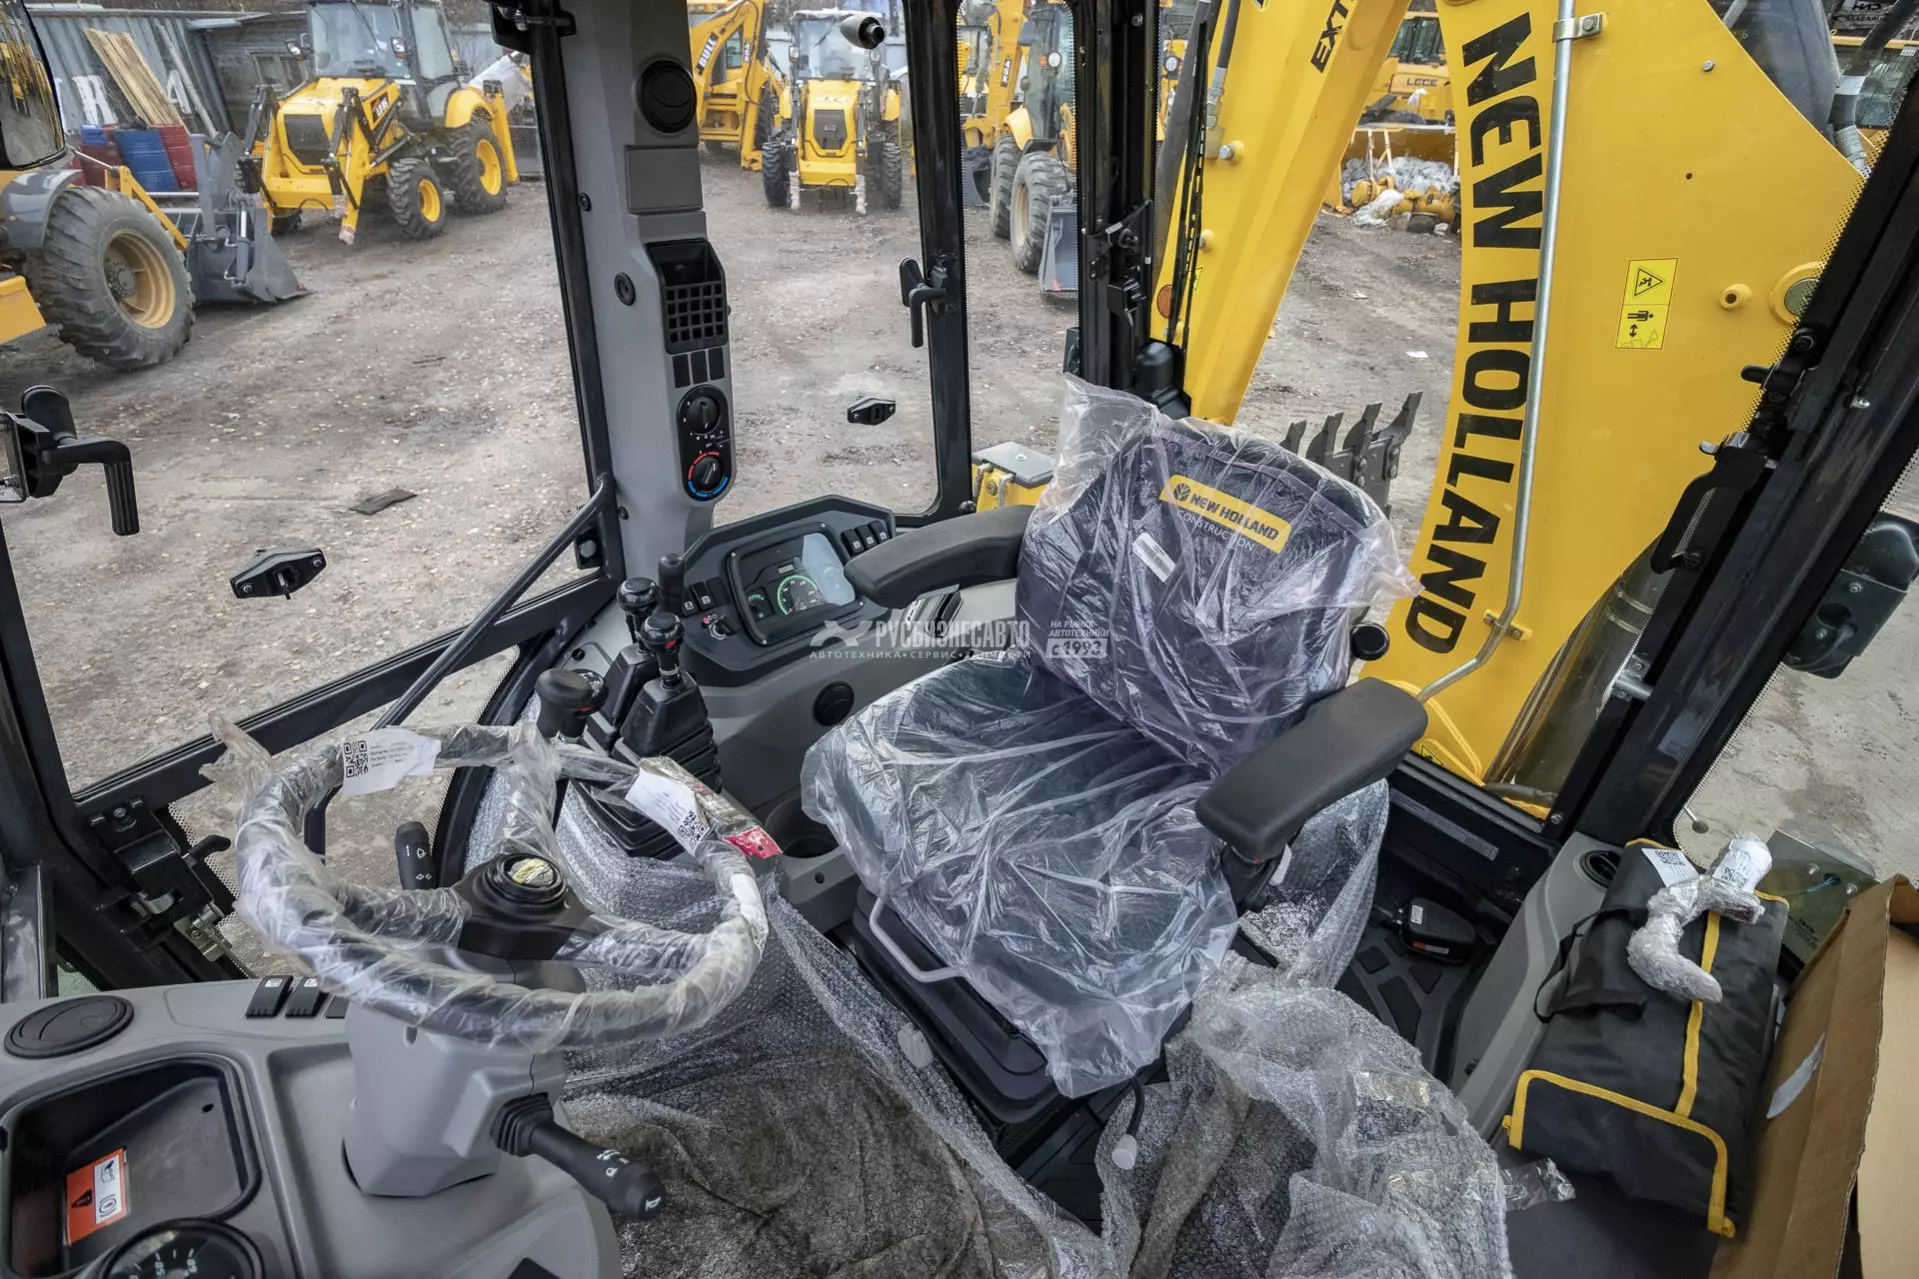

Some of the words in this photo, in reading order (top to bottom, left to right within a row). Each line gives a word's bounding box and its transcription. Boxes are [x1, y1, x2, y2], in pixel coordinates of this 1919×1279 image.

[1310, 0, 1349, 73] EXT
[1461, 12, 1543, 249] NEW
[1405, 278, 1538, 654] HOLLAND
[1178, 510, 1255, 552] CONSTRUCON
[1190, 494, 1221, 513] NEW
[1219, 506, 1280, 541] HOLLAND
